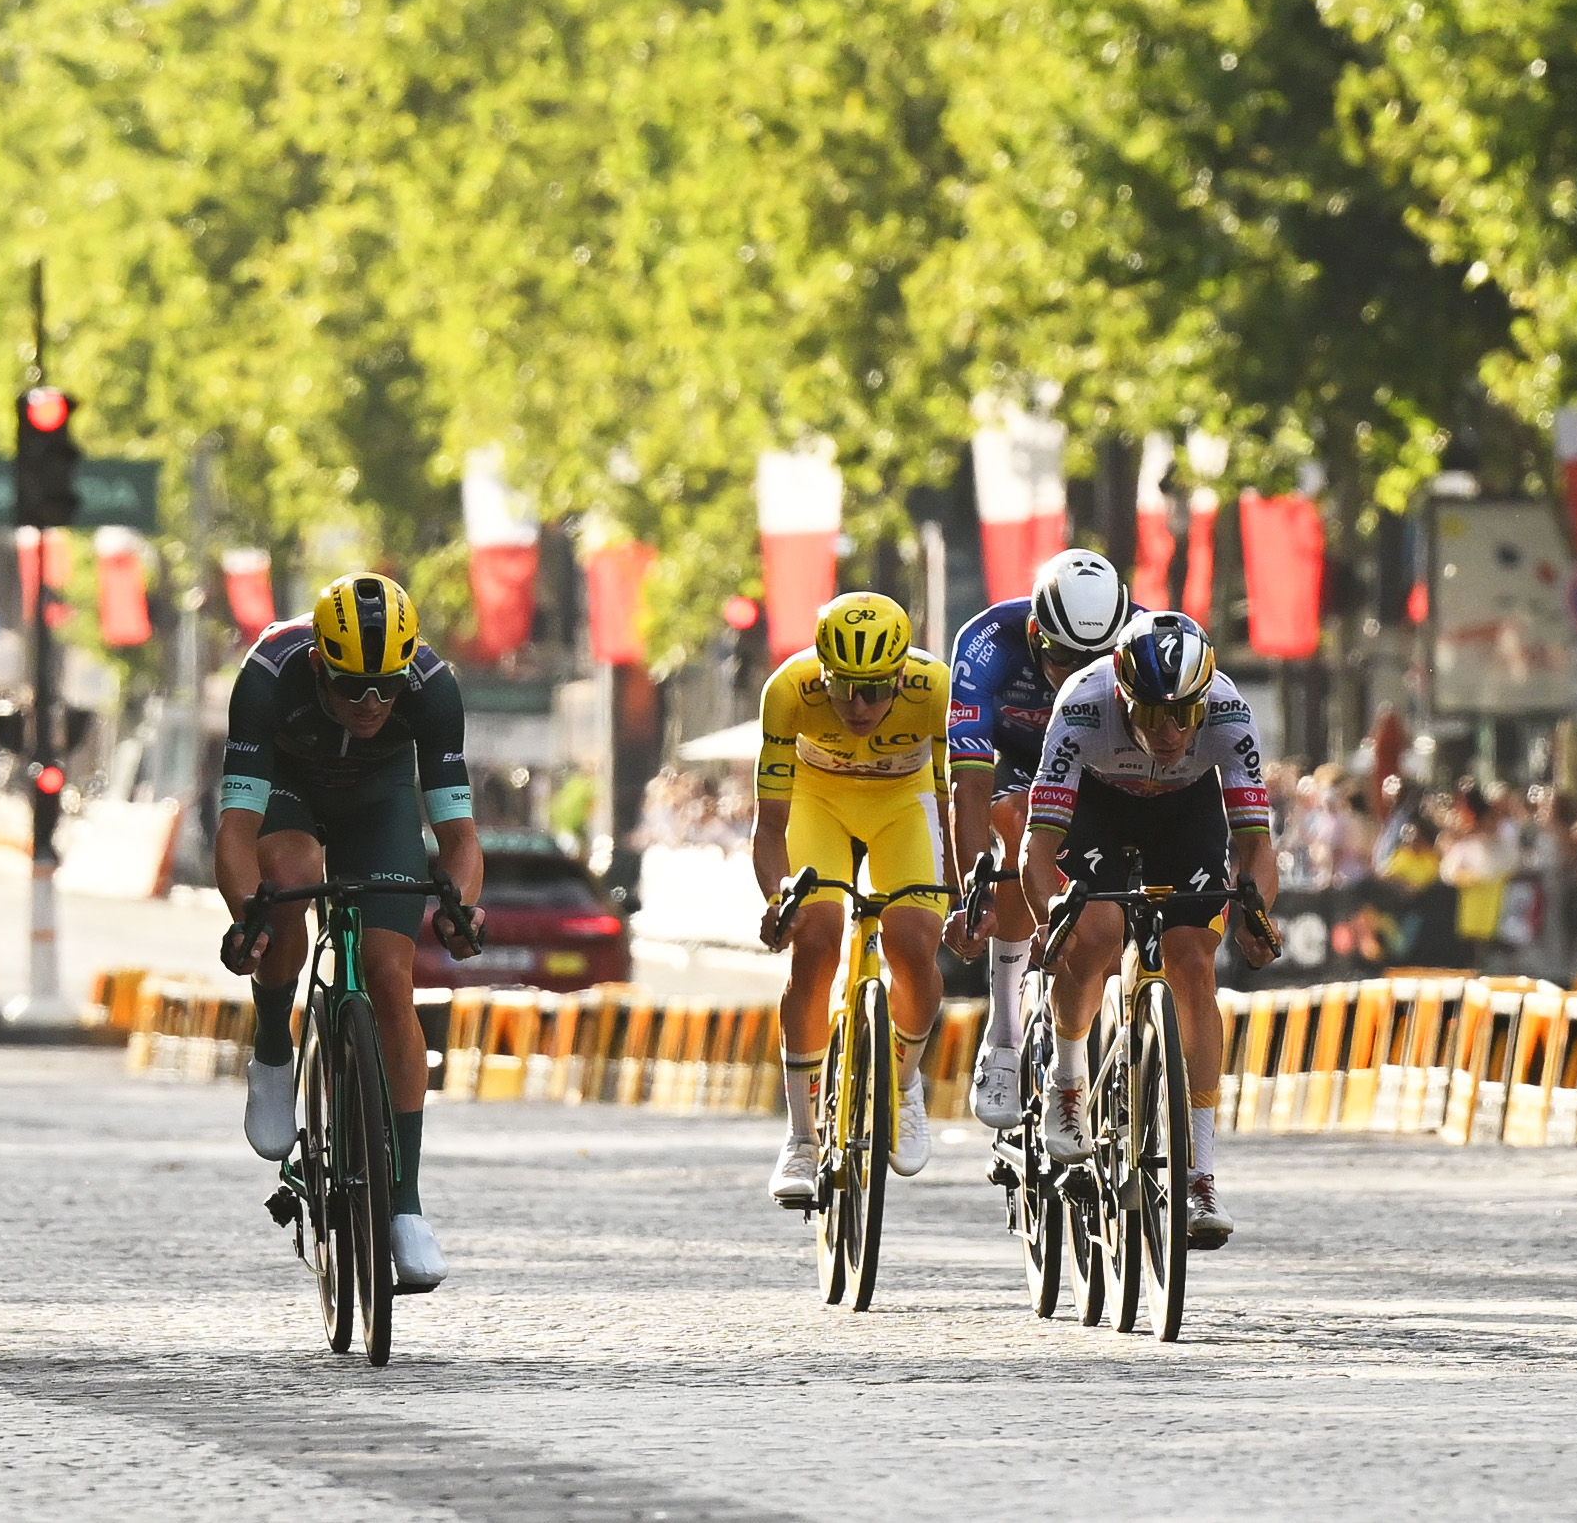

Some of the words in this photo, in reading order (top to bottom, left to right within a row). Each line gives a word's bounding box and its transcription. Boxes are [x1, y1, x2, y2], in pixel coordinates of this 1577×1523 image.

[332, 587, 349, 634] TREK
[964, 621, 1002, 660] PREMIER
[975, 640, 997, 667] TECH
[1061, 703, 1101, 718] BORA
[1209, 699, 1252, 715] BORA
